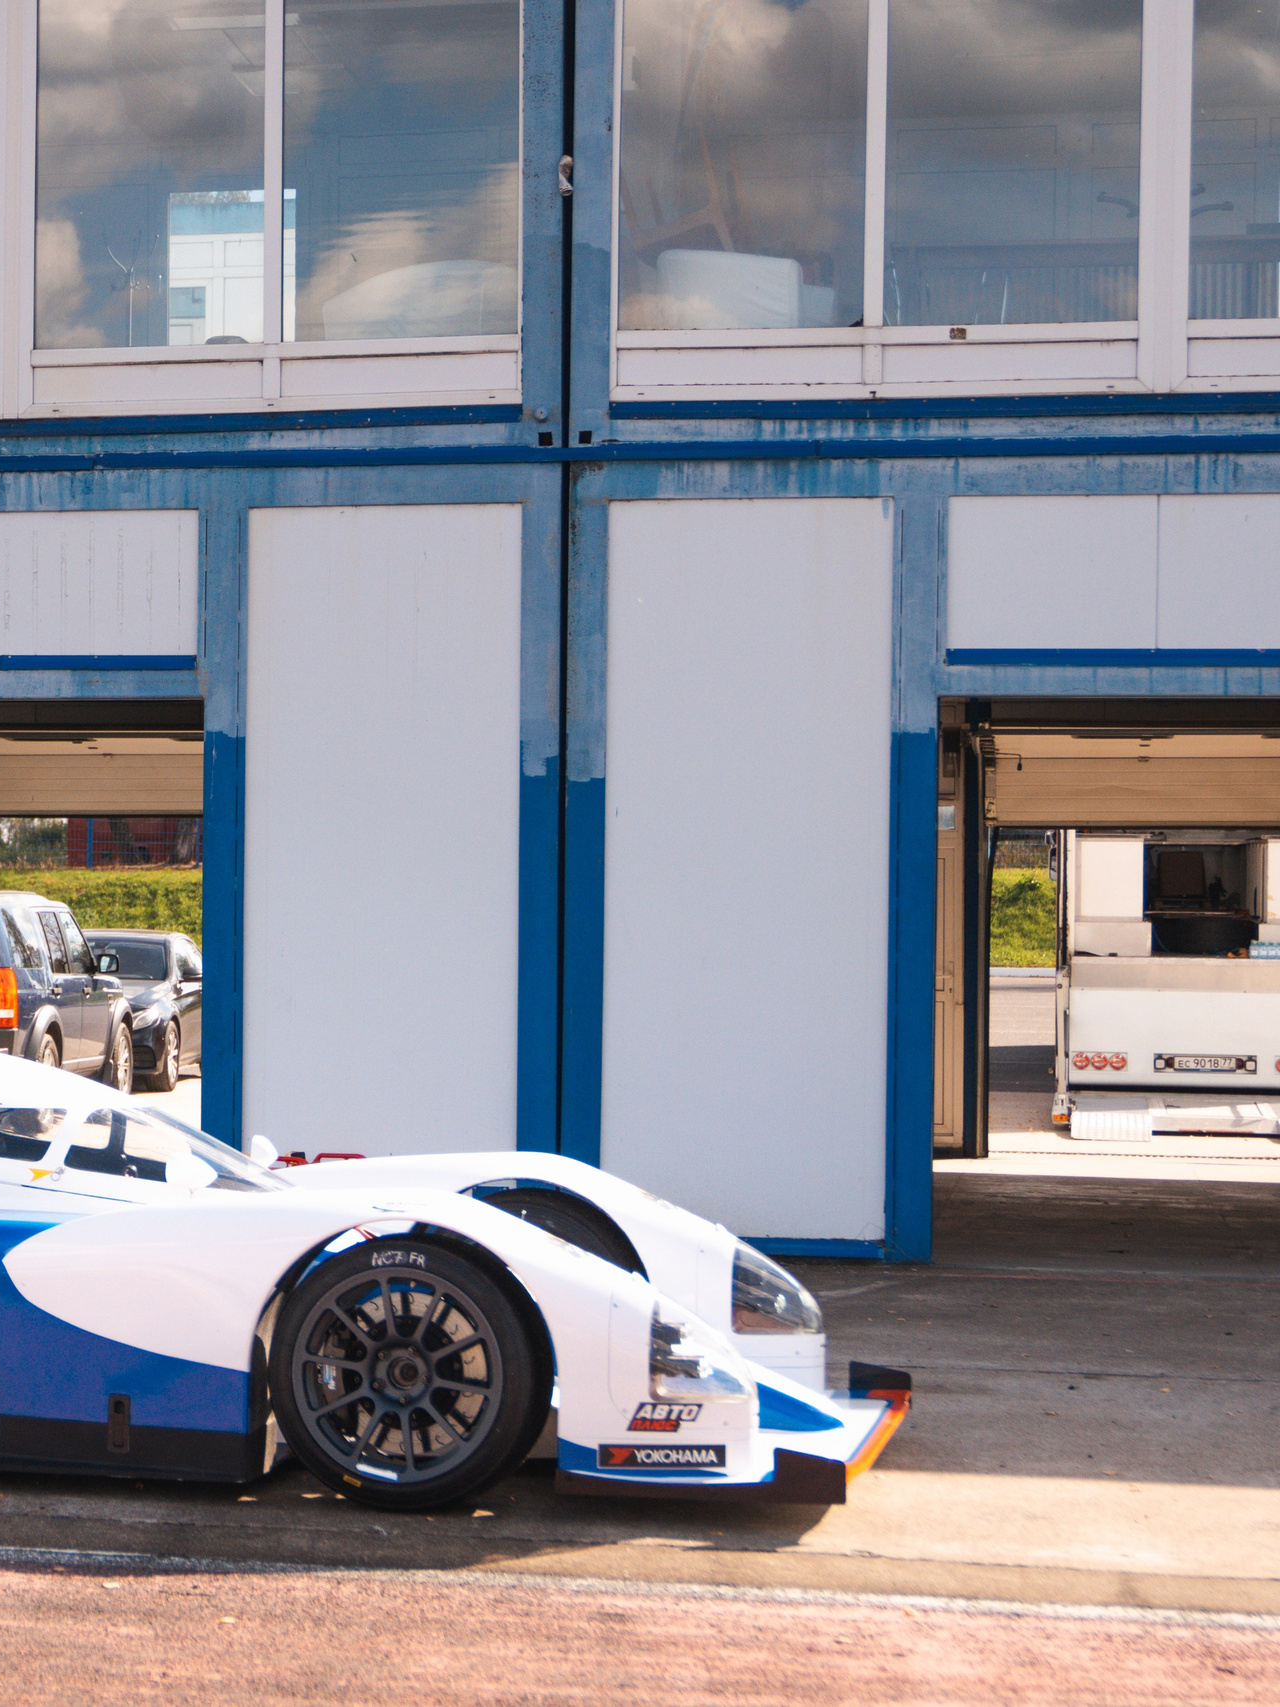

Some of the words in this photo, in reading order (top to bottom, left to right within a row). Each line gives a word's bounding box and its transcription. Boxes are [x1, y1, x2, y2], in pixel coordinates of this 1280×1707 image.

[409, 1252, 426, 1268] FR
[636, 1404, 699, 1420] АВТО
[634, 1449, 718, 1464] YOKOHAMA
